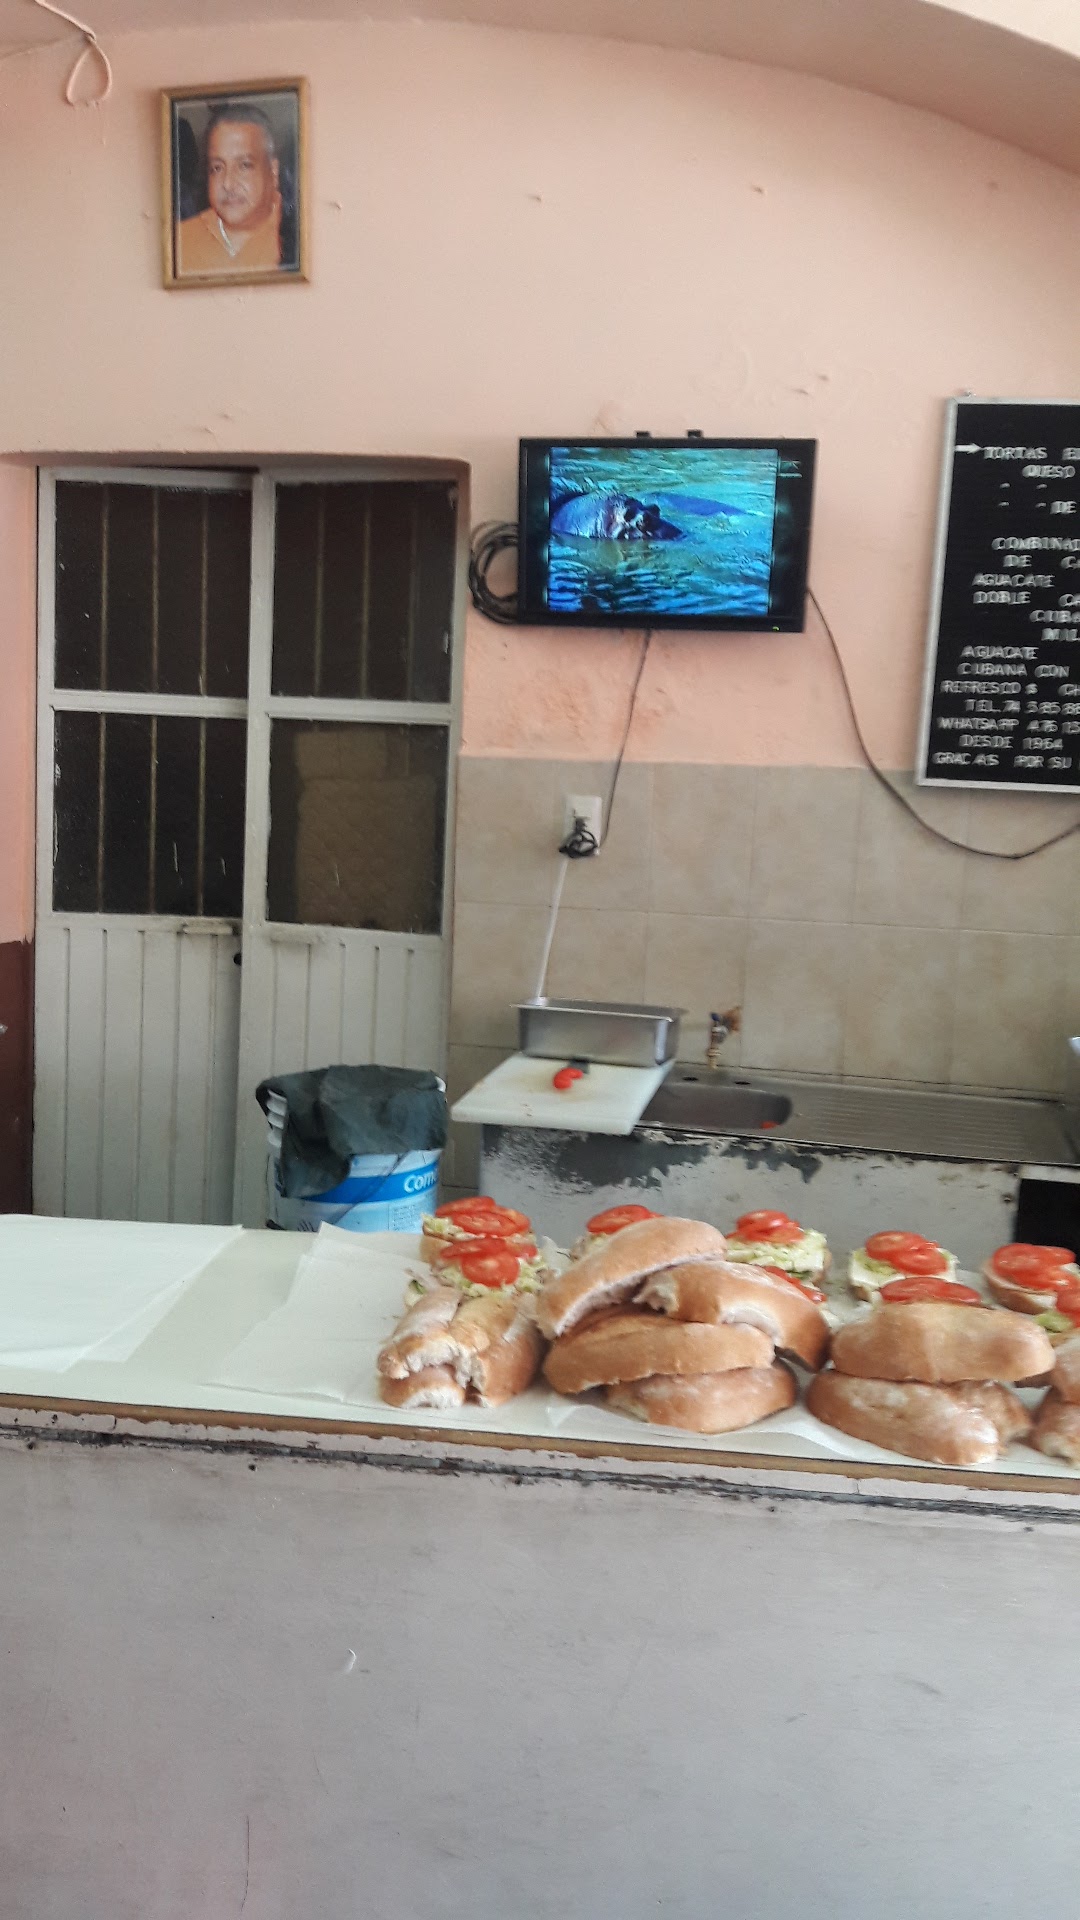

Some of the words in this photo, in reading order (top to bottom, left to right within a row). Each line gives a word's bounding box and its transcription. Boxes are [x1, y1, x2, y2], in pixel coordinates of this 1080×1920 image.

[983, 446, 1048, 460] TORTAS
[1022, 464, 1076, 479] QUESO
[1050, 500, 1077, 514] DE
[1003, 554, 1033, 568] DE
[972, 573, 1055, 588] AGUACATE
[973, 591, 1031, 605] DOBLE
[961, 645, 1039, 660] AGUACATE
[957, 662, 1028, 677] CUBANA
[1034, 664, 1070, 678] CON
[959, 734, 1014, 749] DESDE
[1014, 755, 1044, 769] POR
[1047, 756, 1073, 769] SU
